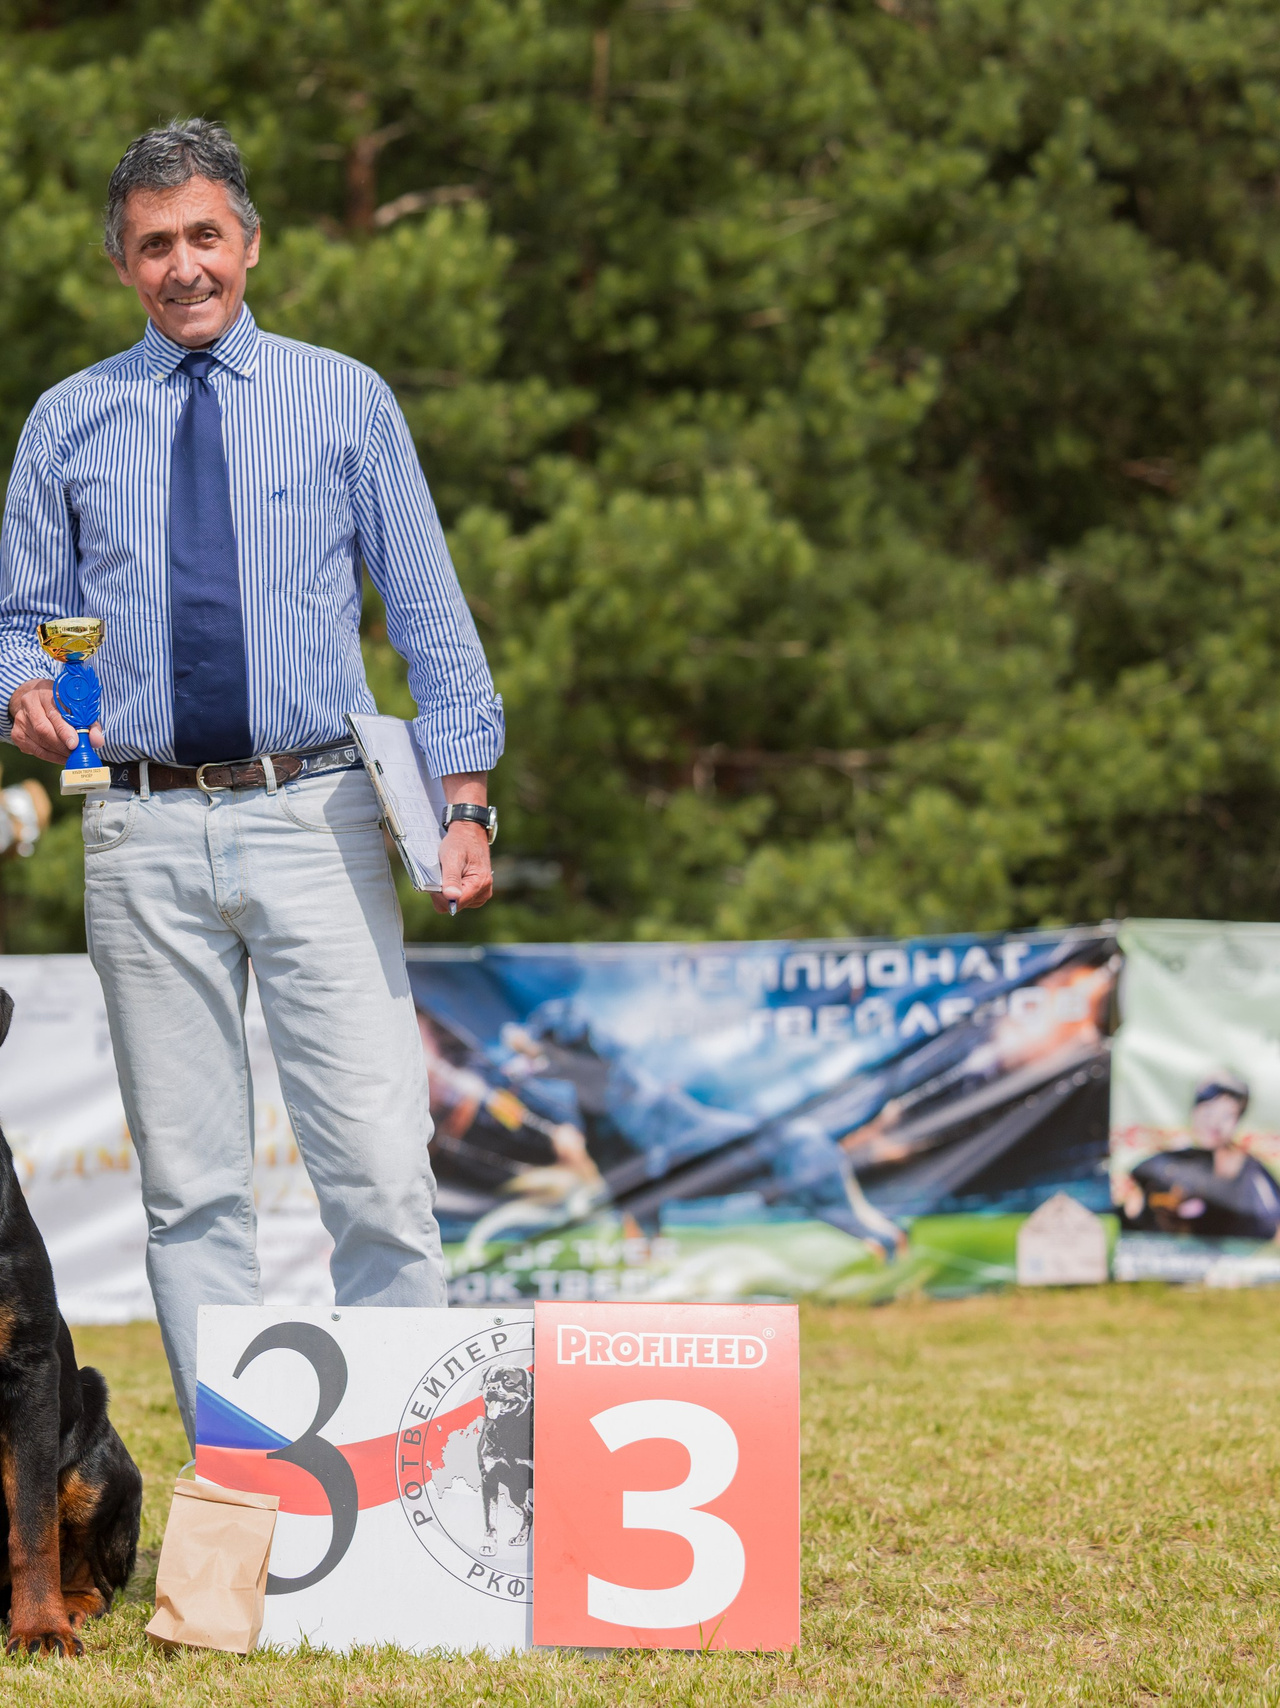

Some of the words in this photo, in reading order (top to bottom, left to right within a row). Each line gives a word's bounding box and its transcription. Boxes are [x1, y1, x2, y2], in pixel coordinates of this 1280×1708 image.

[658, 943, 1031, 992] ЧЕМПИОНАТ
[401, 1332, 508, 1527] РОТВЕЙЛЕР
[557, 1324, 767, 1369] PROFIFEED
[232, 1321, 359, 1595] 3
[587, 1399, 746, 1629] 3
